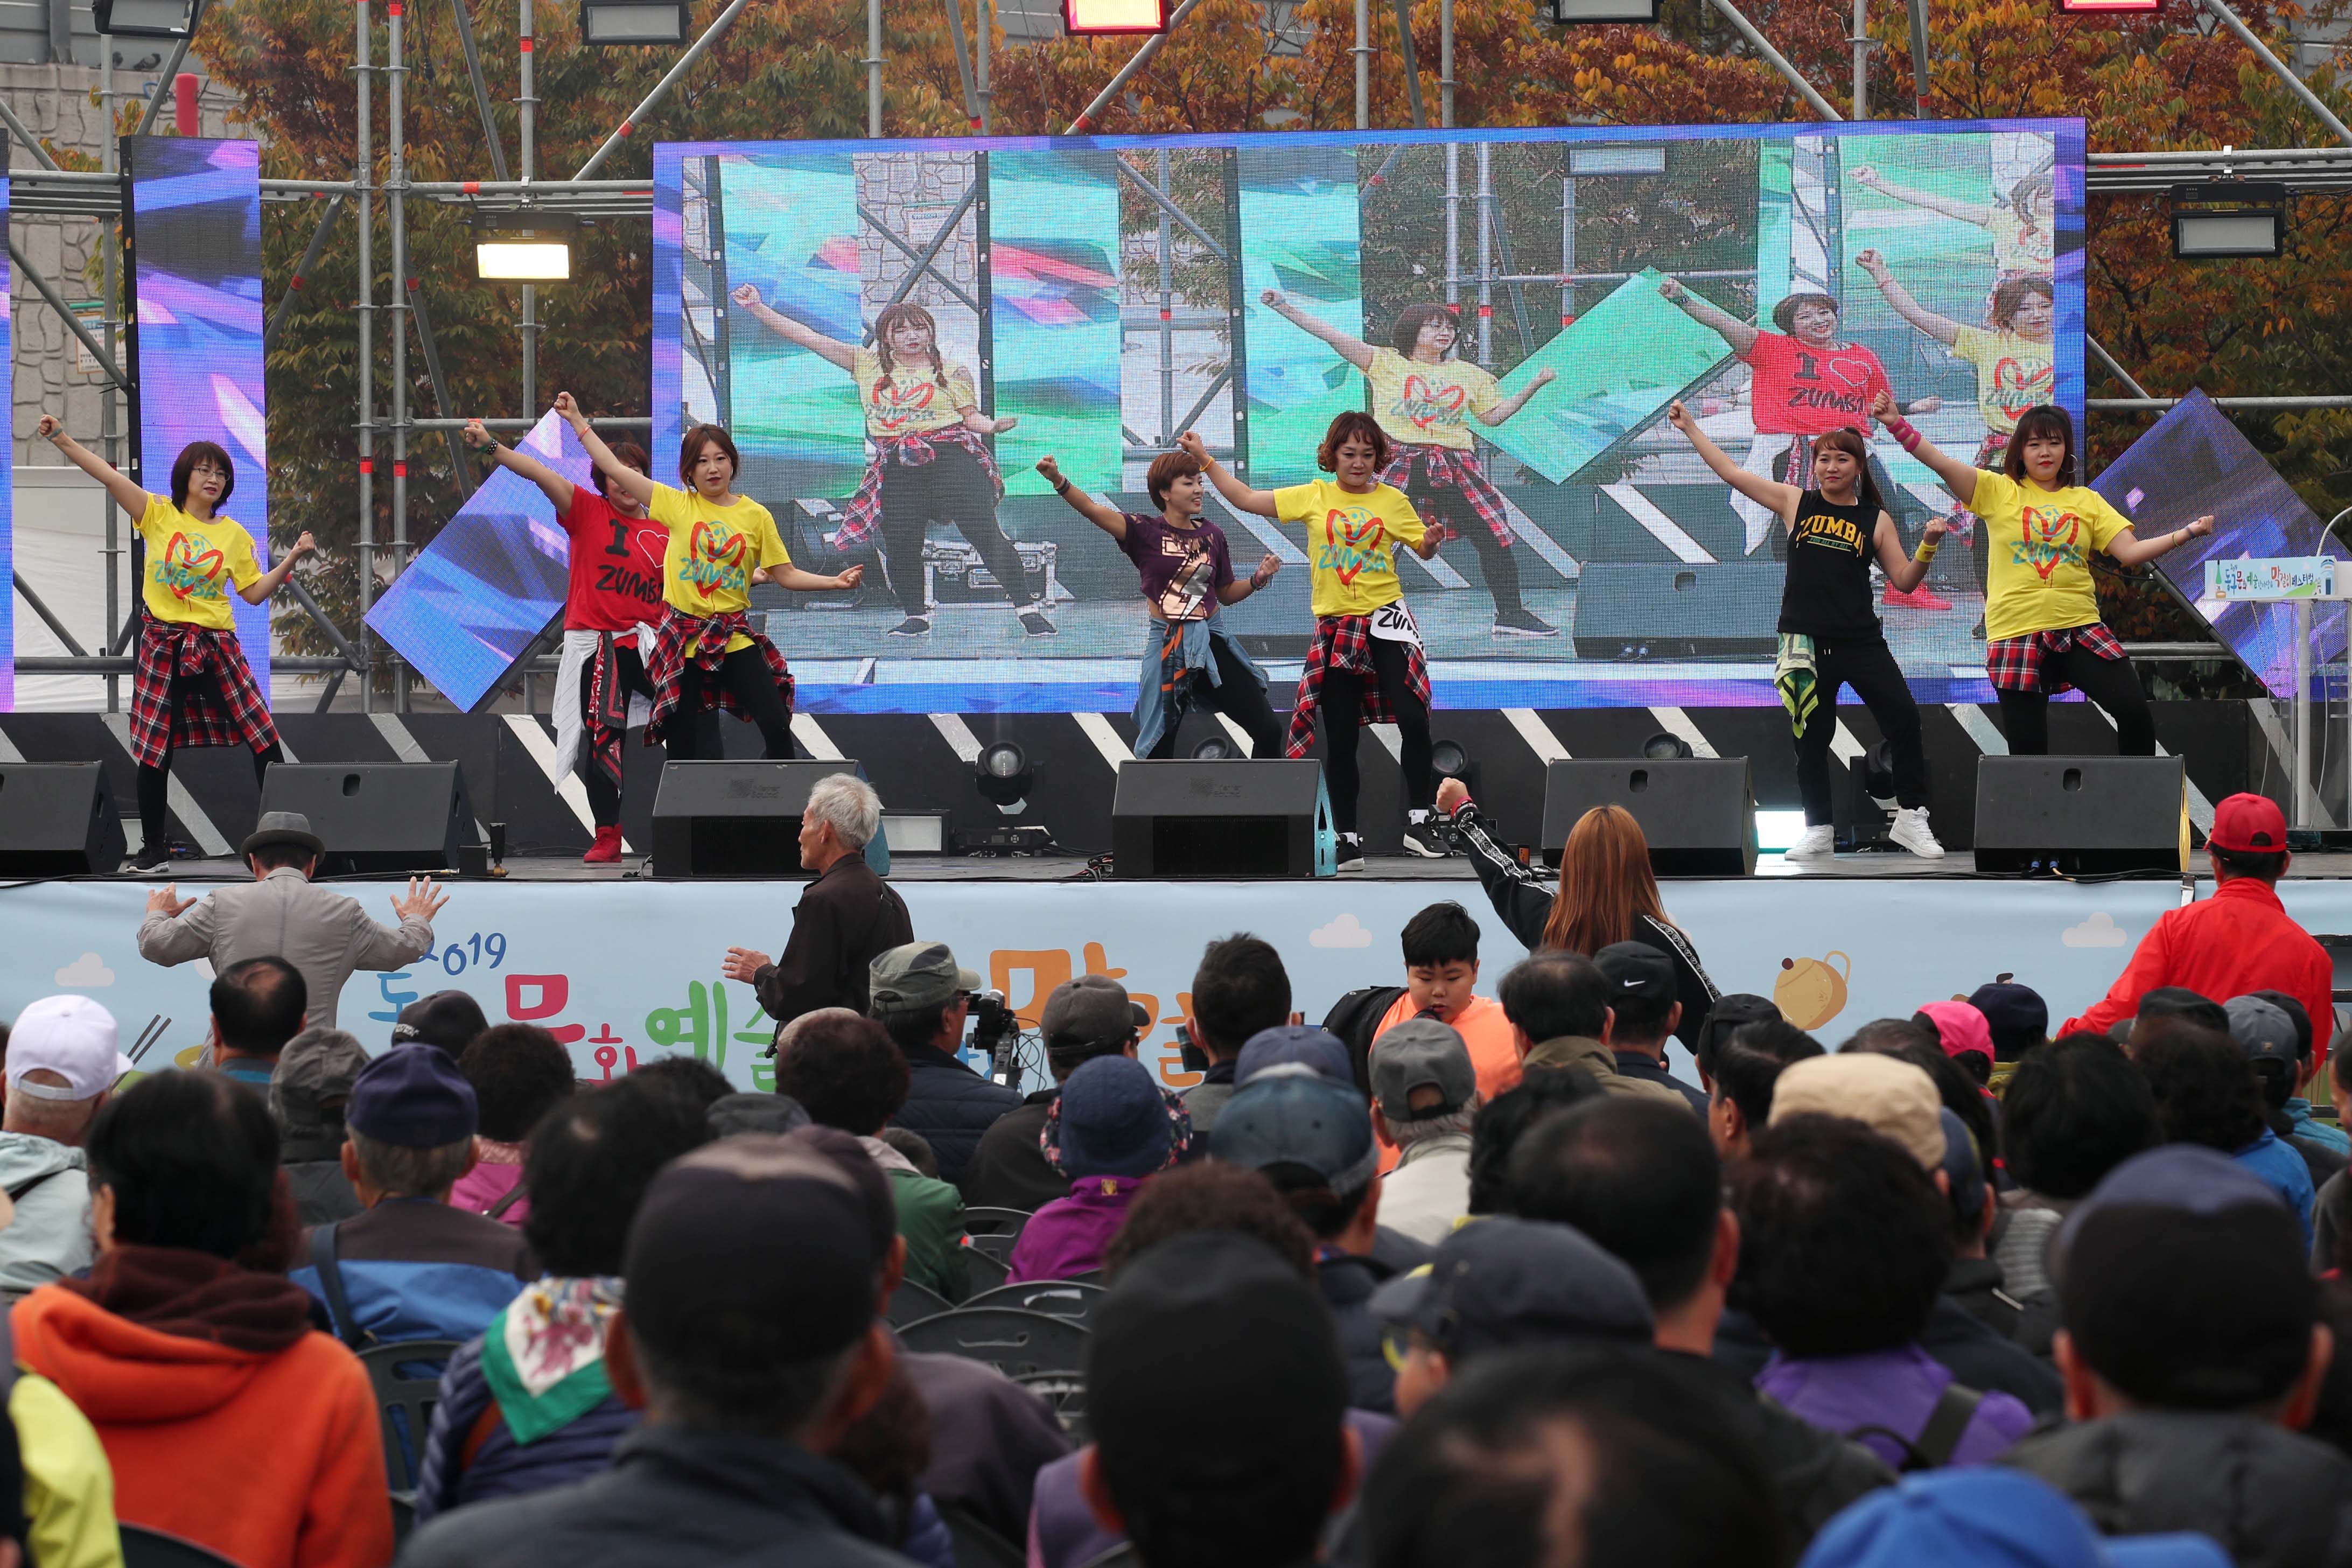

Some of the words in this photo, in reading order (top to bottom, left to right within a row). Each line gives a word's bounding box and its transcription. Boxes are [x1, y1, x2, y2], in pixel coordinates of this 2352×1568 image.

[605, 519, 630, 557] I
[1796, 515, 1864, 556] ZUMBA
[2010, 540, 2082, 566] ZUMBA
[679, 557, 745, 591] ZUMBA
[1319, 543, 1388, 573] ZUMBA
[154, 560, 218, 599] ZUMBA
